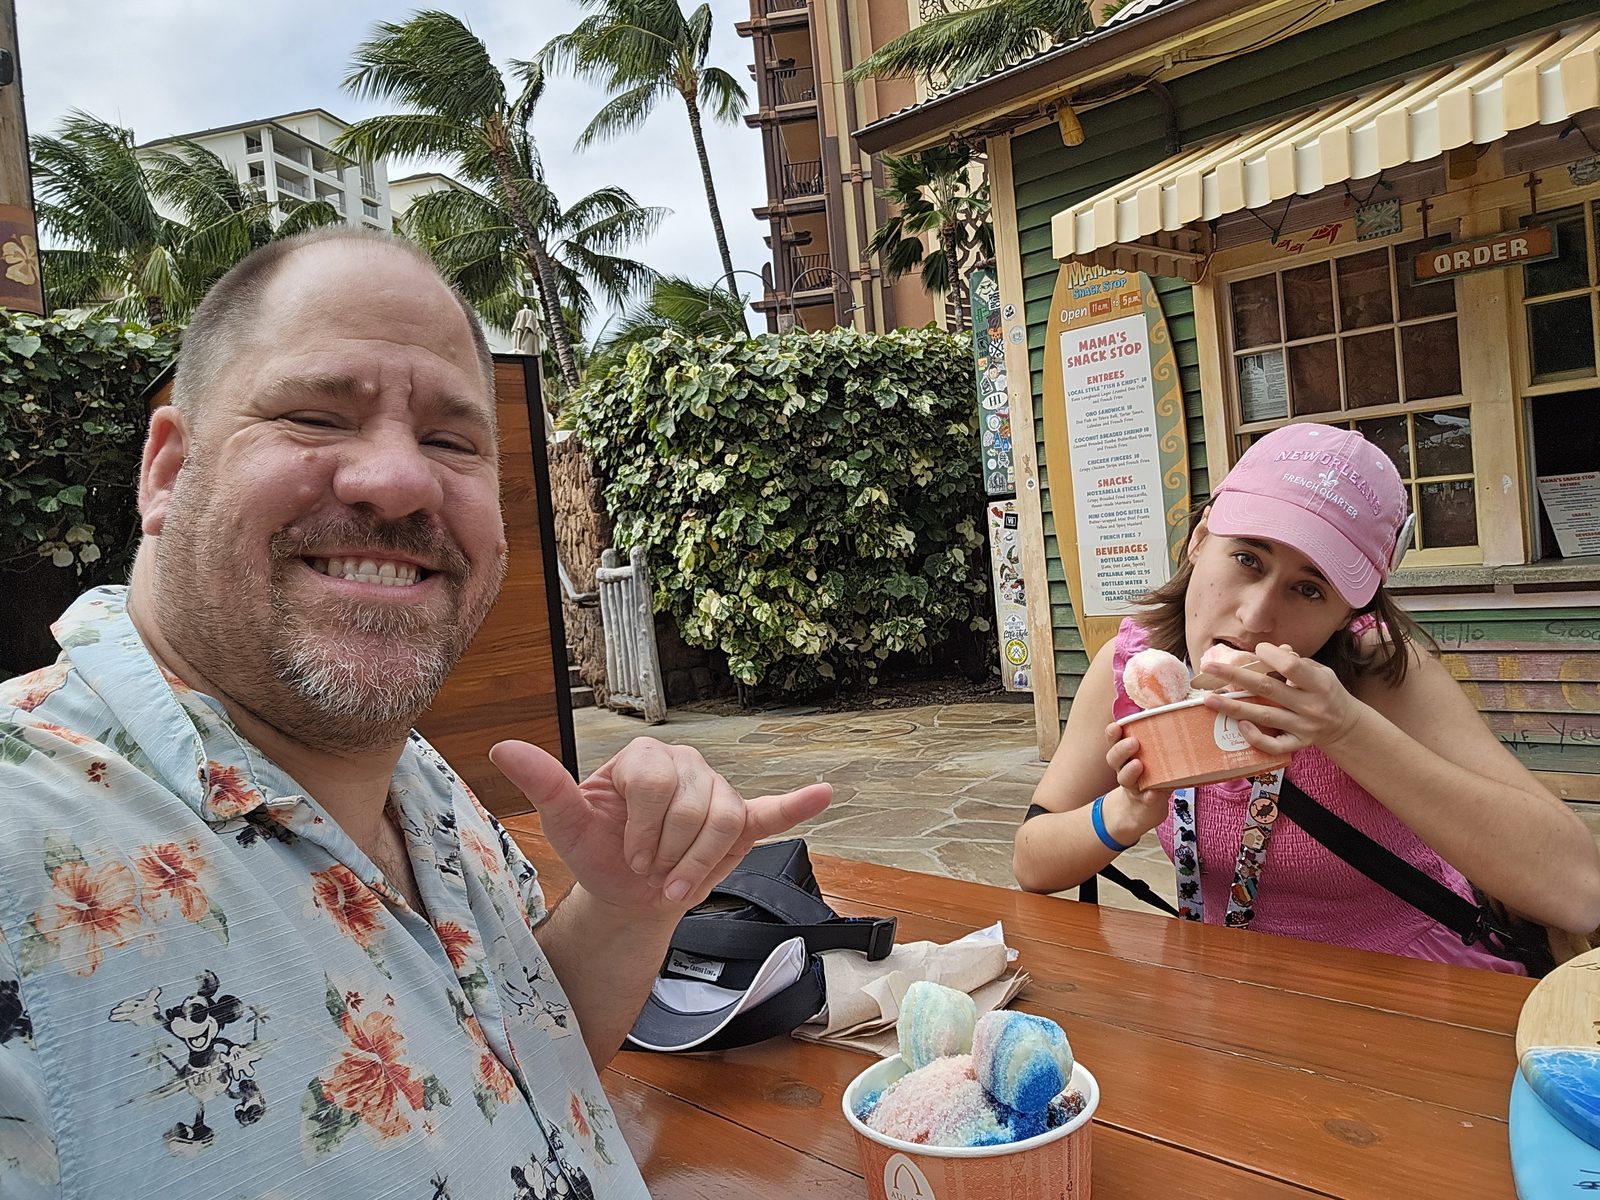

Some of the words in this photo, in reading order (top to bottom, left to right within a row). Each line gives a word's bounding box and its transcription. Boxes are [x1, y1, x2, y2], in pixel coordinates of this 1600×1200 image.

[1433, 238, 1529, 274] ORDER
[1073, 284, 1101, 299] SNACK
[1103, 278, 1127, 293] STOP
[1060, 307, 1088, 325] Open
[1078, 331, 1128, 352] MAMA'S
[1067, 350, 1107, 368] SNACK
[1110, 342, 1142, 359] STOP
[1087, 370, 1124, 384] ENTREES
[1068, 388, 1084, 397] LOCAL
[1086, 385, 1100, 394] STYLE
[989, 394, 1001, 406] HI
[1098, 406, 1125, 416] SANDWICH
[1074, 434, 1098, 444] COCONUT
[1100, 431, 1122, 440] BREADED
[1124, 428, 1143, 436] SHRIMP
[1098, 475, 1133, 488] SNACKS
[1274, 450, 1321, 462] NEW
[1319, 453, 1381, 516] ORLEANS
[1087, 488, 1120, 496] MOZZARELLA
[1282, 473, 1319, 492] FRENCH
[1320, 488, 1358, 518] QUARTER
[1096, 544, 1148, 556] BEVERAGES
[1432, 623, 1484, 648] Hello
[1222, 732, 1242, 740] AULA
[673, 959, 690, 971] Disney
